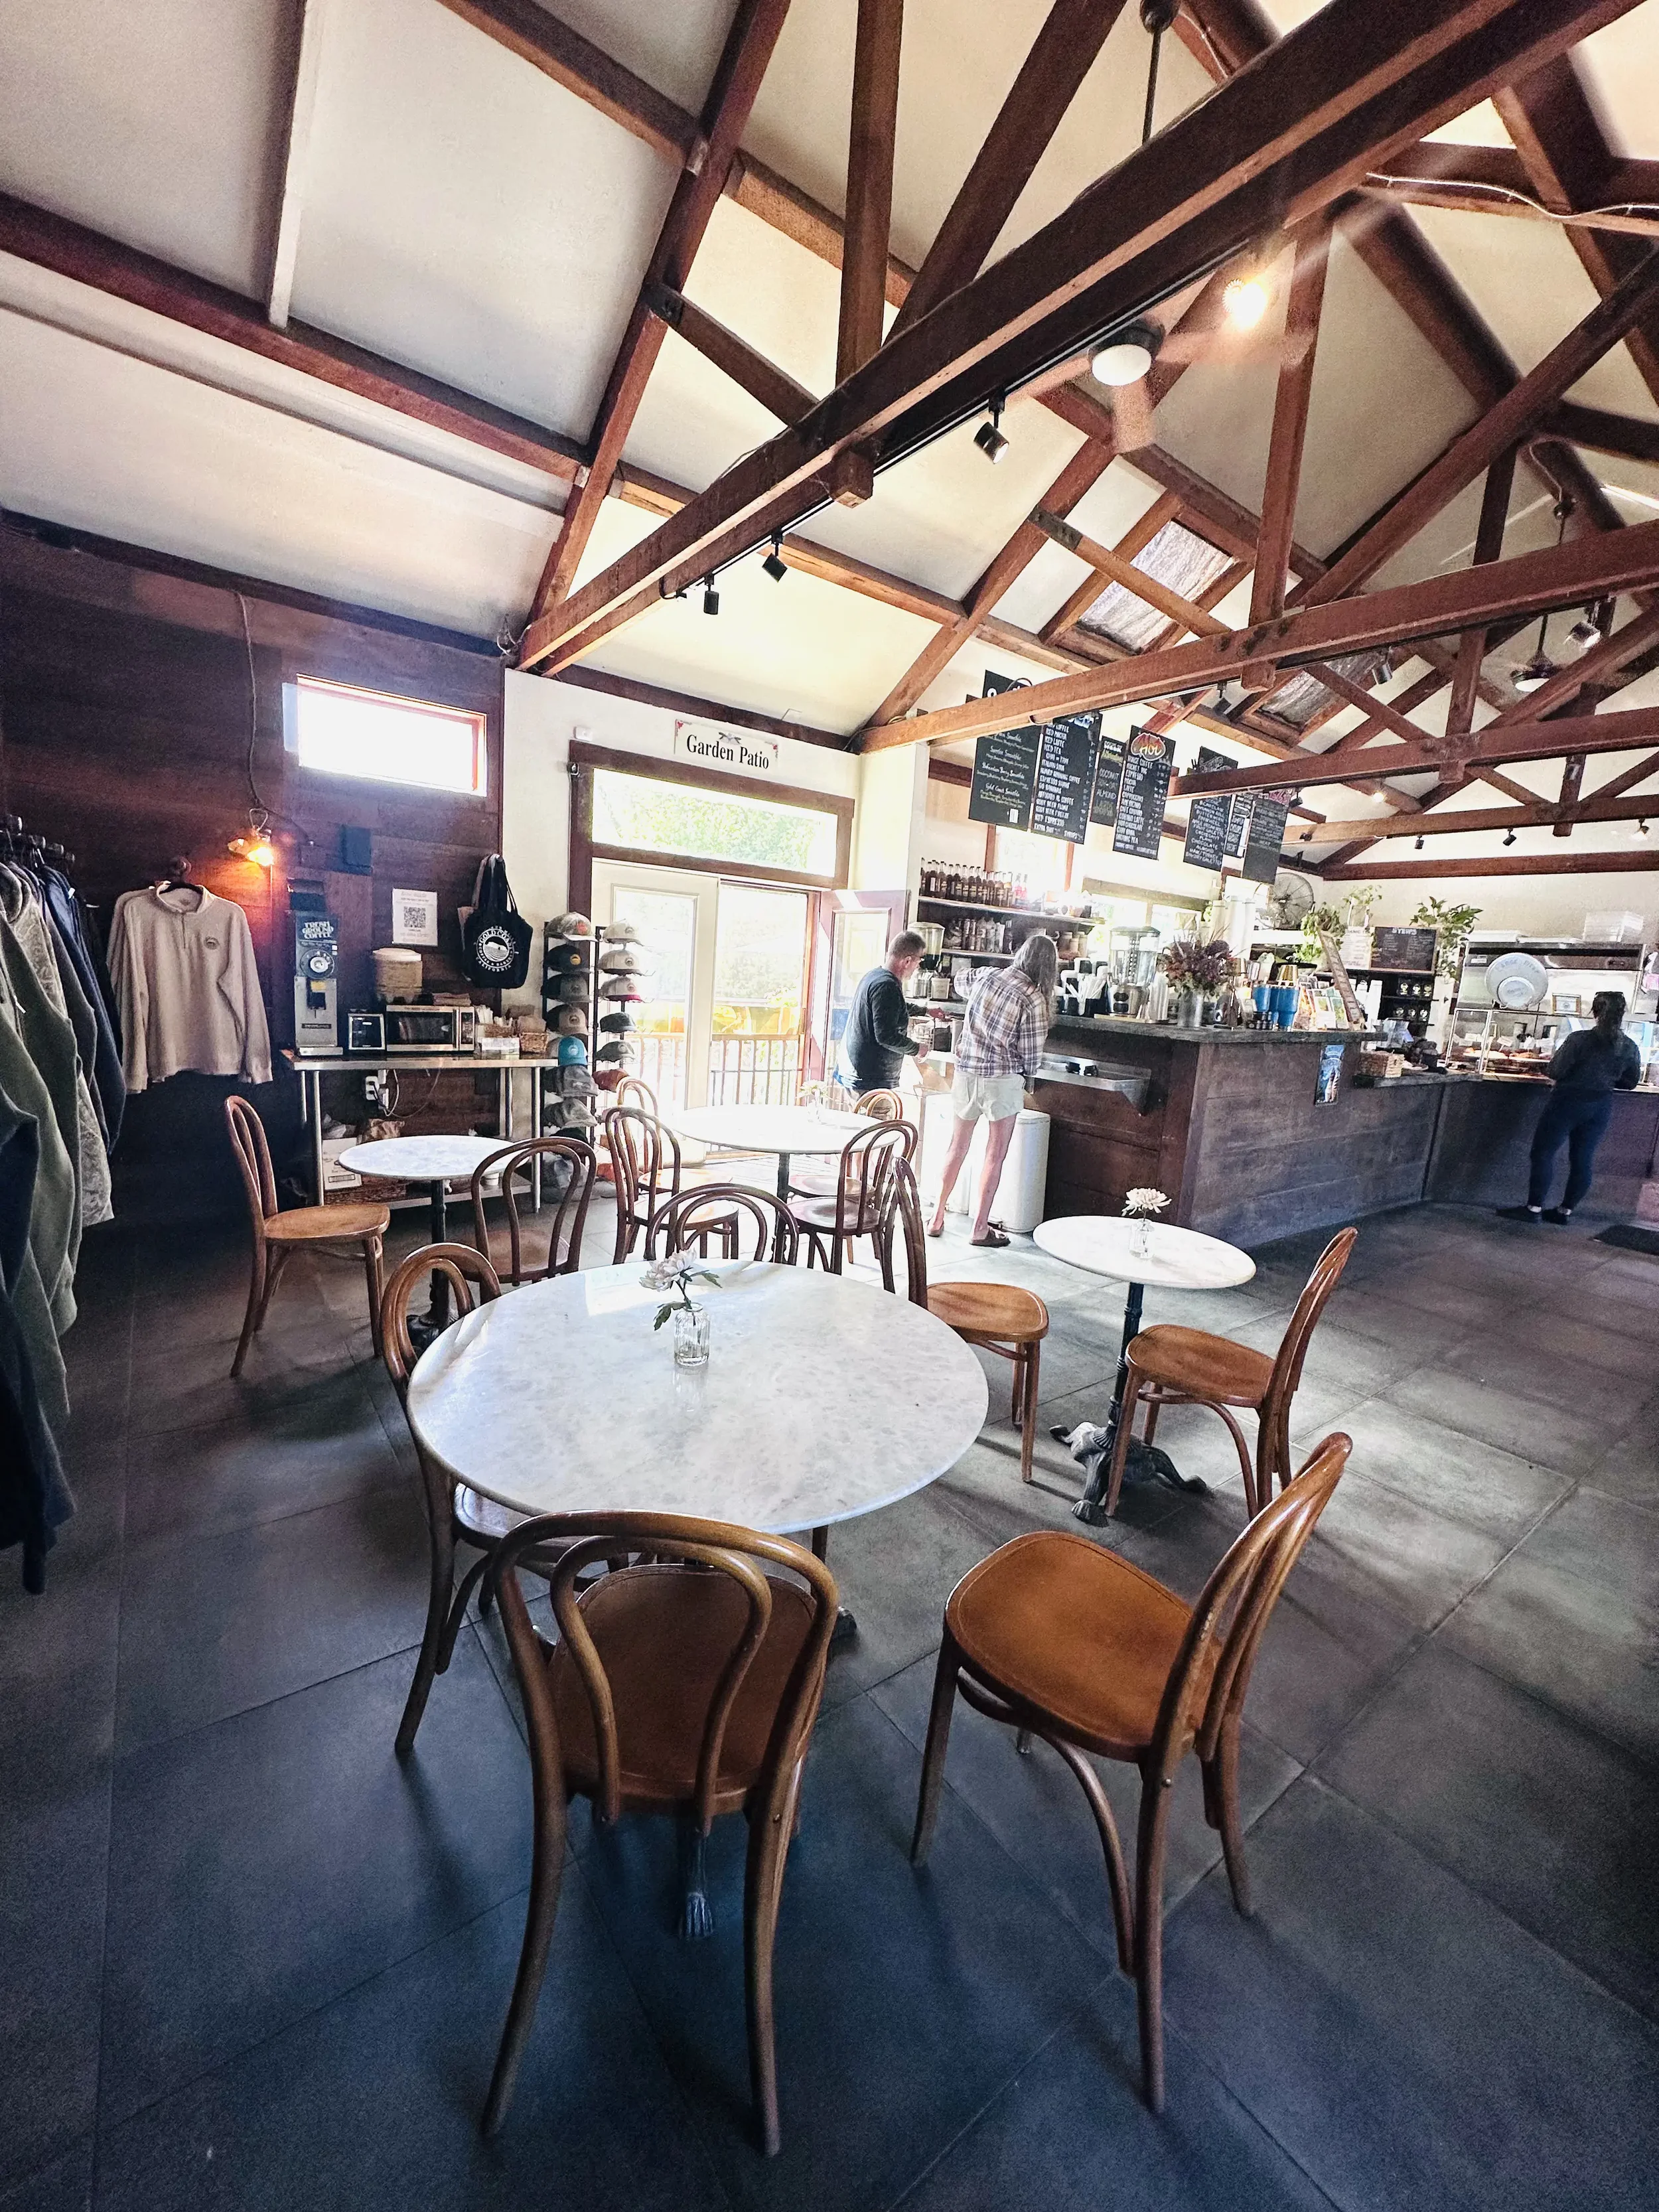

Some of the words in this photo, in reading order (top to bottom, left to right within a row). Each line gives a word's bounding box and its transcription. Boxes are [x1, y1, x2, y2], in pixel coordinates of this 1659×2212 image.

[687, 734, 733, 761] Garden
[739, 747, 769, 769] Patio
[1191, 838, 1218, 850] CHOCOLATE
[479, 930, 496, 943] GOLD
[497, 930, 512, 949] COAST
[476, 956, 512, 972] CALIFORNIA
